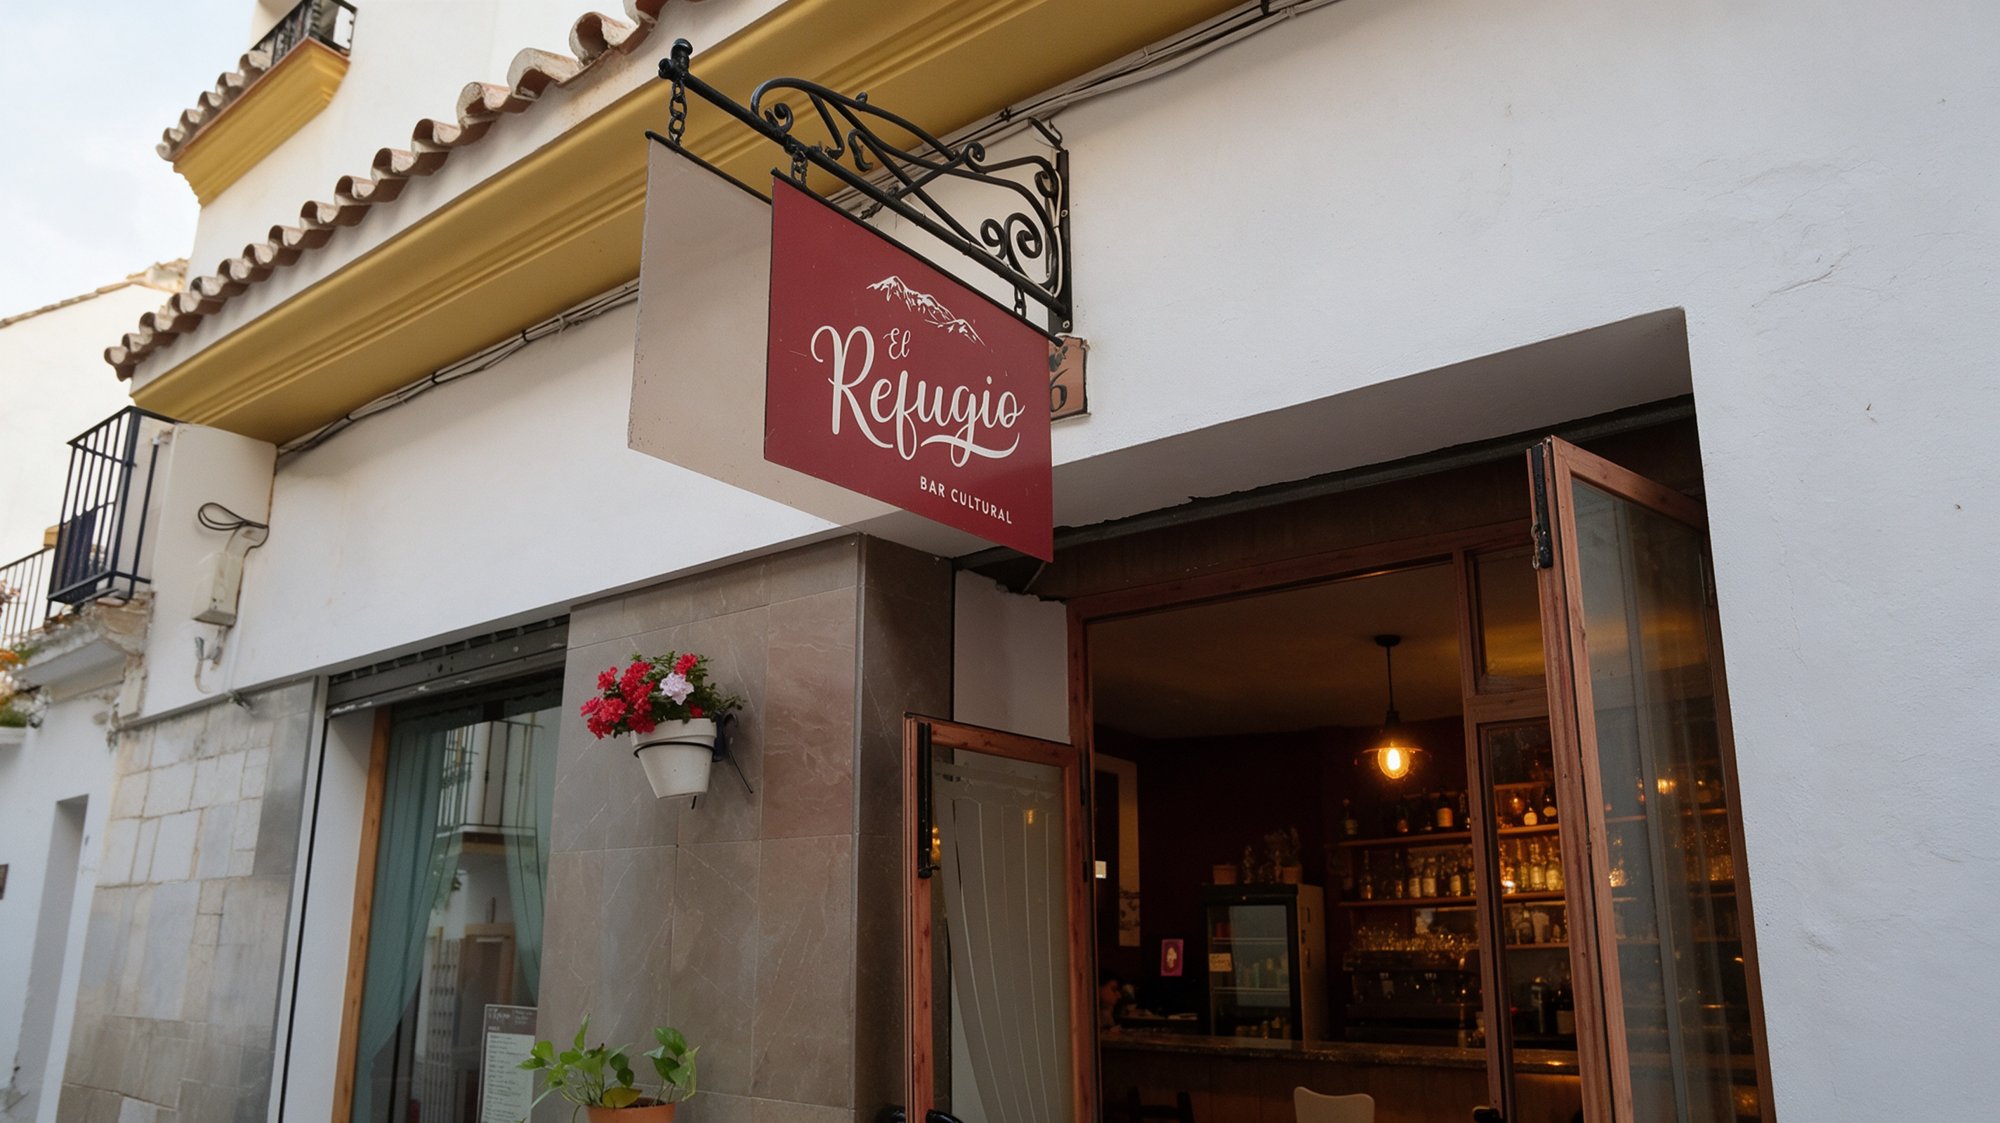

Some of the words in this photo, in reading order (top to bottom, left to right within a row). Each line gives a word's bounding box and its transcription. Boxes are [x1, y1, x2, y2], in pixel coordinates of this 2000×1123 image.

[883, 327, 911, 360] El
[811, 325, 1025, 467] Refugio
[920, 475, 946, 498] BAR
[950, 488, 1013, 525] CULTURAL
